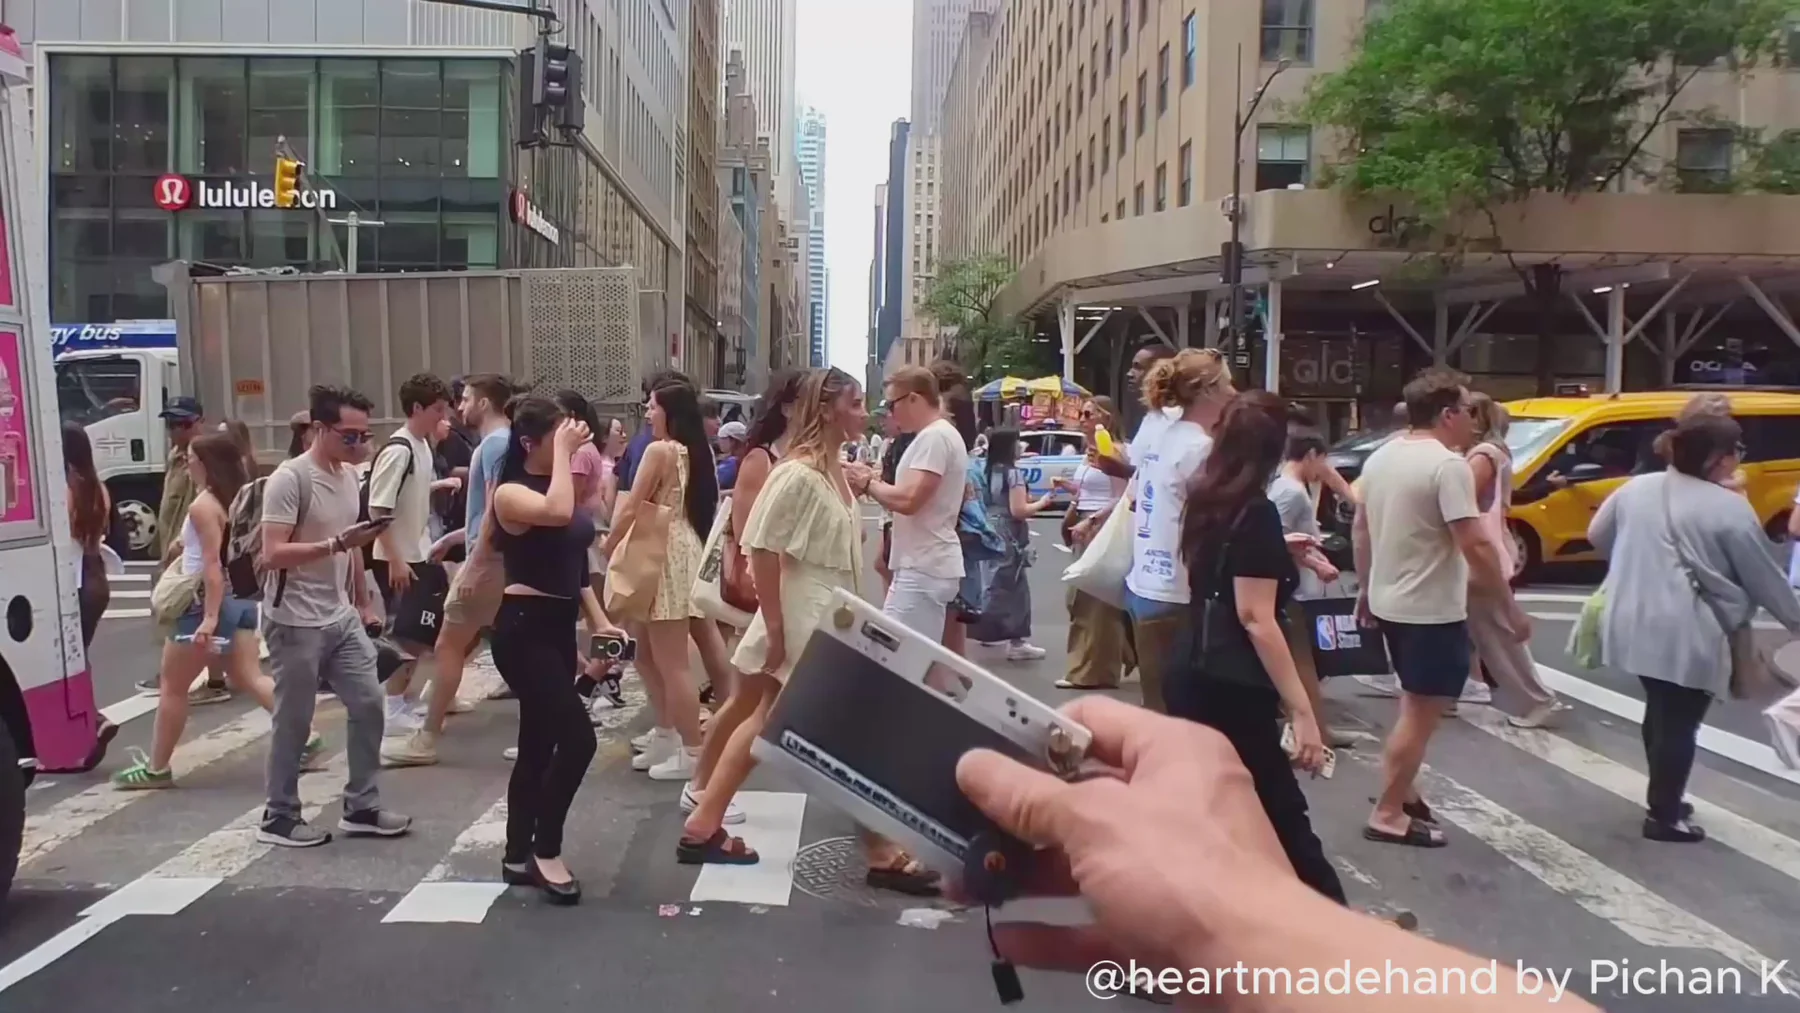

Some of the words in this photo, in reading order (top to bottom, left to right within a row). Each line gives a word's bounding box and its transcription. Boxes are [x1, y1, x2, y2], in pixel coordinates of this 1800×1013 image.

[199, 180, 336, 208] lululeon
[79, 324, 123, 340] bus
[421, 610, 436, 628] BR
